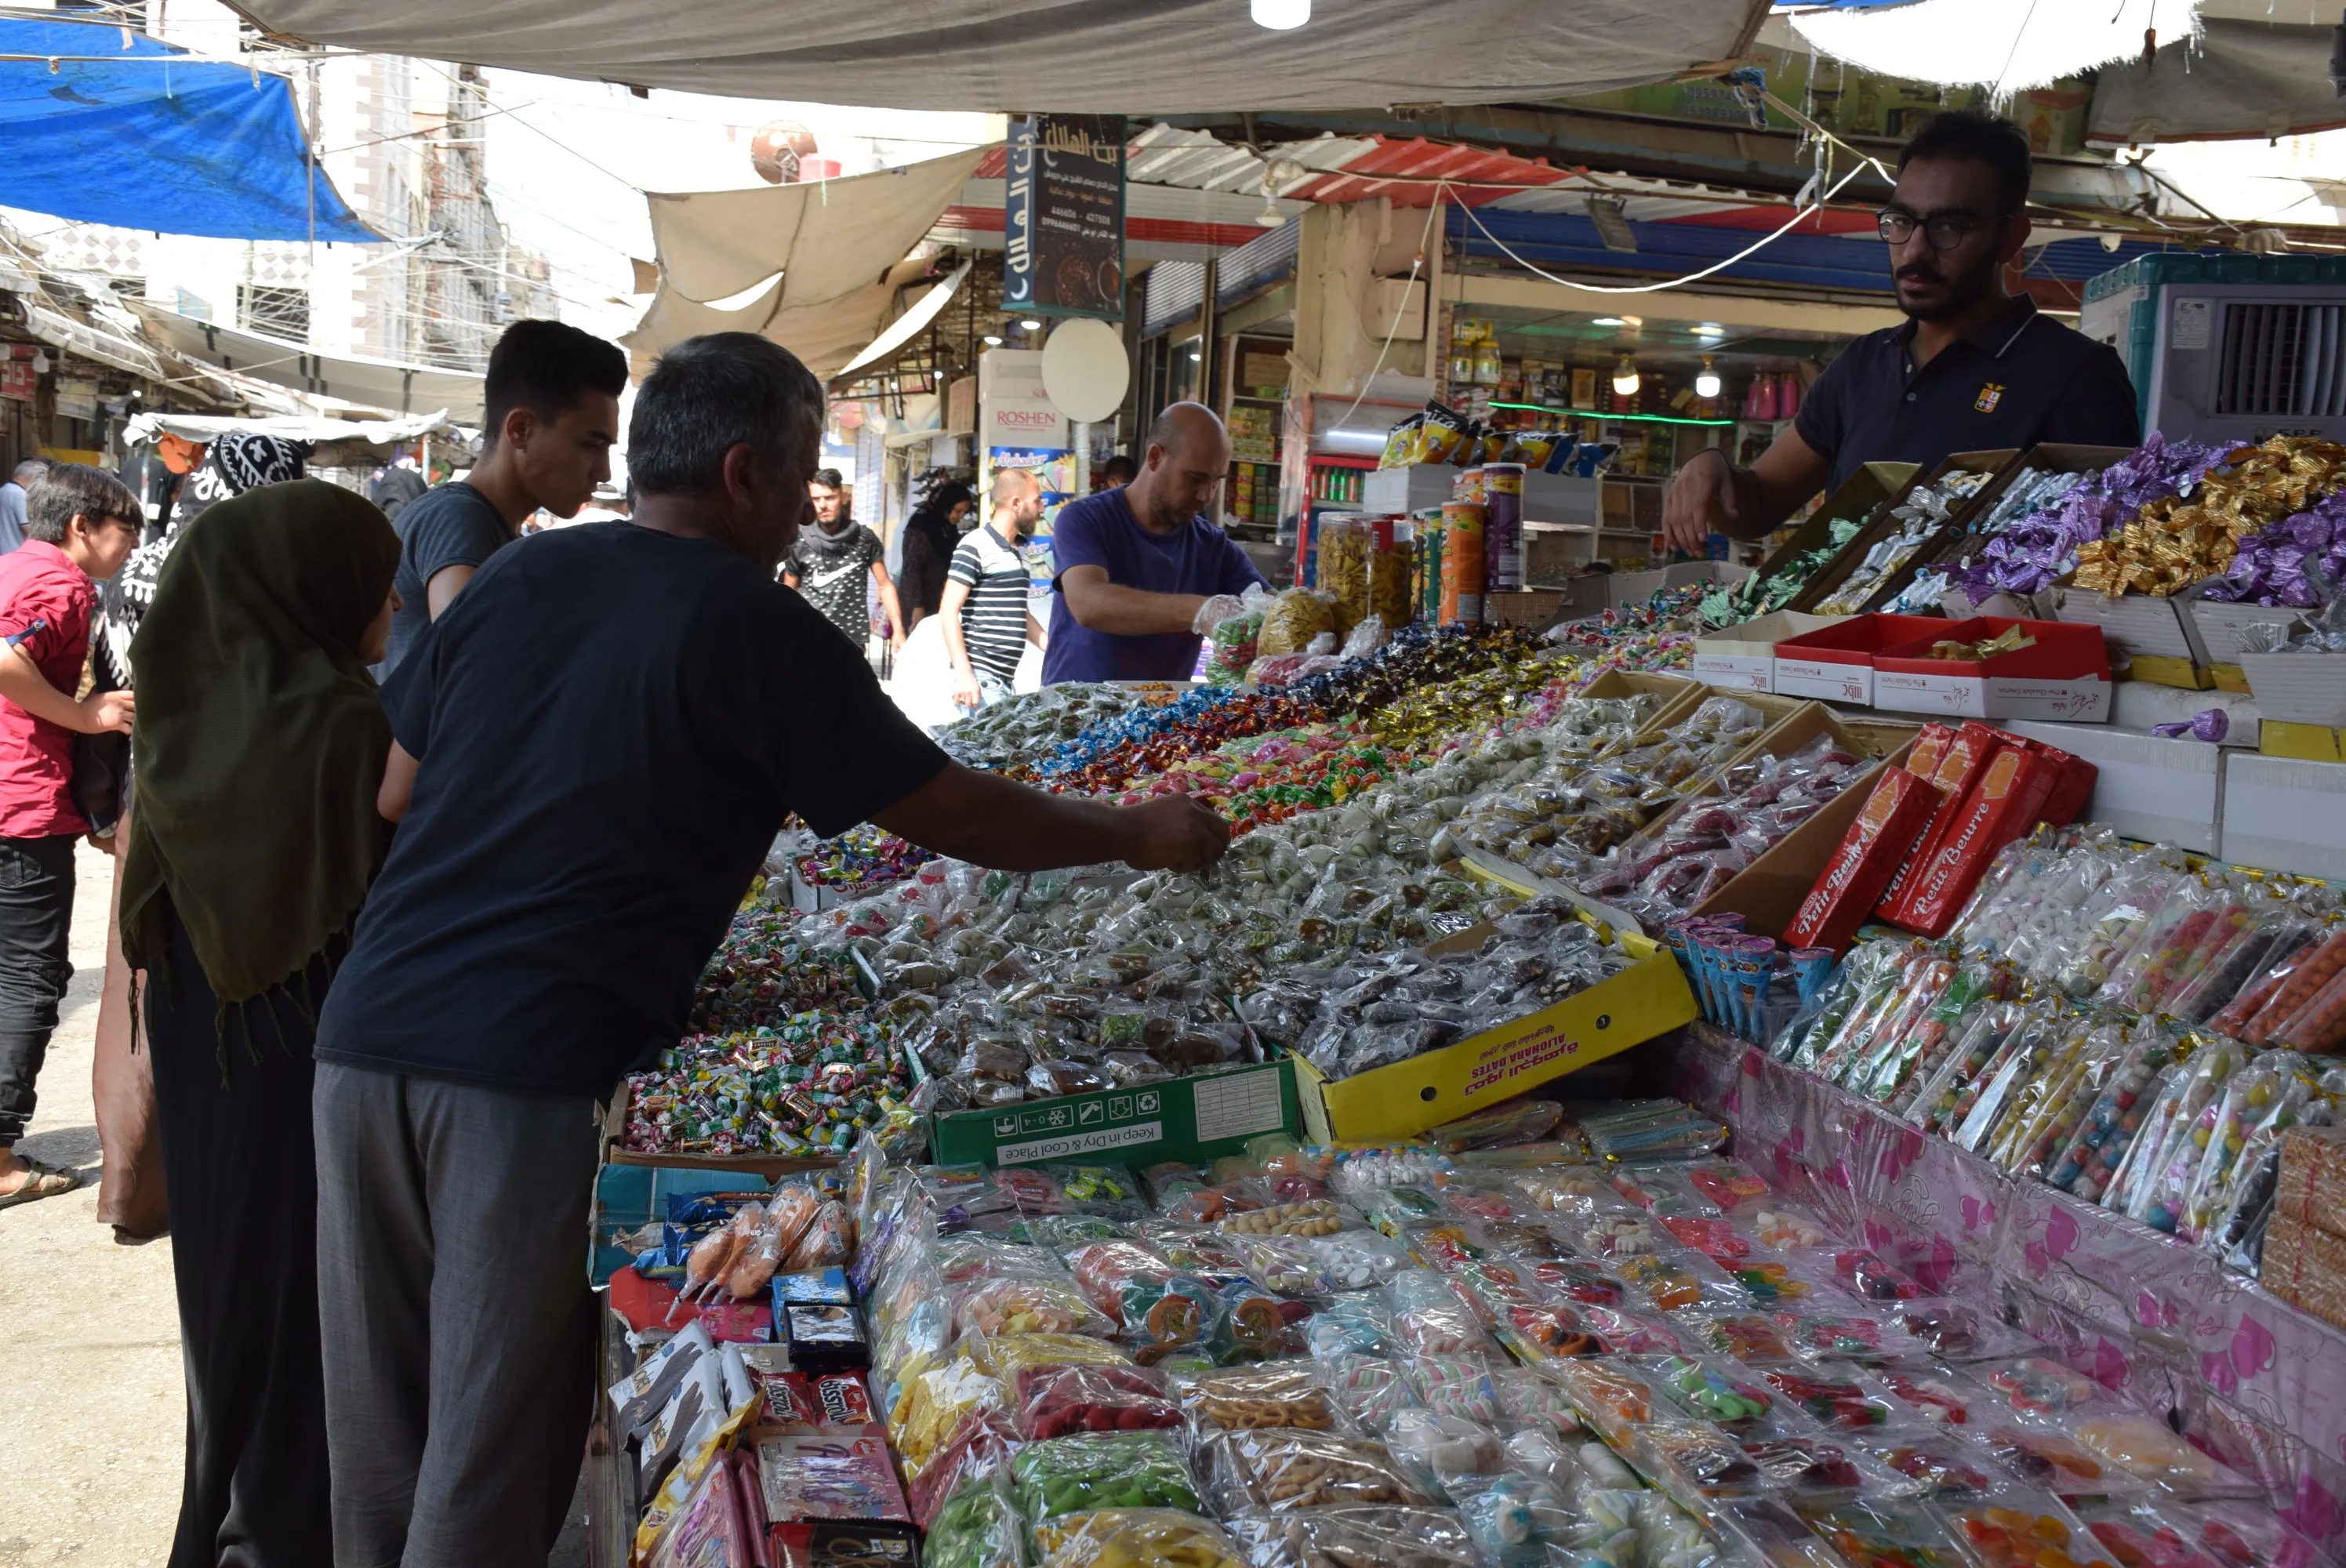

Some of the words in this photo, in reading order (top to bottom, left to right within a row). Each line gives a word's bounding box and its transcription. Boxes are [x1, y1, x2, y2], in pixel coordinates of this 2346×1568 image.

[997, 410, 1055, 424] ROSHEN
[1751, 675, 1767, 690] mbc
[1843, 684, 1862, 700] mbc
[1913, 869, 1948, 915] Petit
[1943, 802, 1989, 866] Beurre
[1798, 890, 1831, 935] Petit
[1827, 832, 1868, 889] Beurre
[1509, 1033, 1565, 1063] ALJOHARA
[1464, 1068, 1504, 1096] تمور
[1509, 1041, 1578, 1078] الجوهرة
[1472, 1057, 1506, 1079] DATES
[793, 1097, 812, 1112] CAPRICE
[1039, 1116, 1045, 1124] 0
[1109, 1133, 1120, 1144] in
[1123, 1127, 1153, 1140] Keep
[1072, 1140, 1080, 1149] &
[1084, 1136, 1106, 1147] Dry
[1005, 1146, 1038, 1159] Place
[1042, 1142, 1069, 1156] Cool
